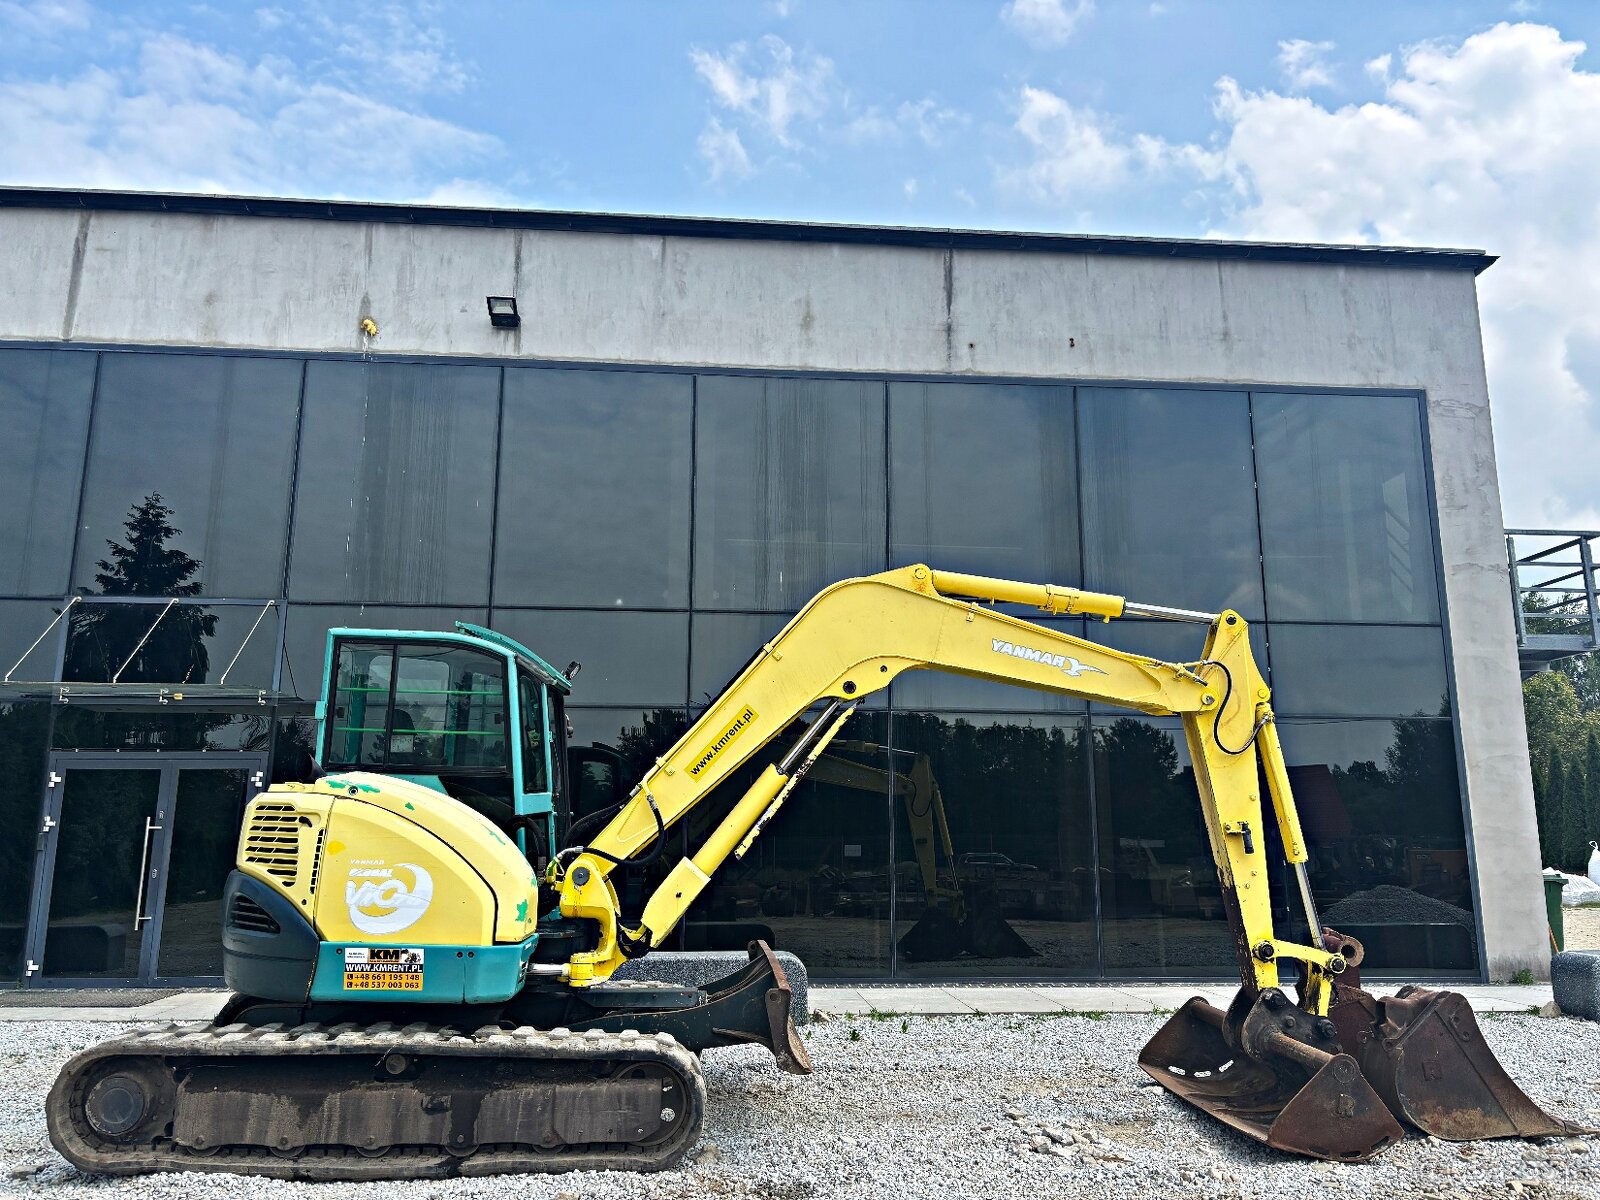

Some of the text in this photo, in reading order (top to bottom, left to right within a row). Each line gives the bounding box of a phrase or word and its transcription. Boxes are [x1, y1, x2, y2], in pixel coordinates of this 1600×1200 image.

[991, 638, 1066, 668] YANMAR
[690, 708, 754, 775] www.kmrent.pl
[369, 949, 401, 960] KM
[345, 963, 423, 973] WWW.KMRENT.PL
[354, 973, 370, 981] +48
[371, 973, 386, 981] 661
[388, 973, 403, 981] 195
[354, 981, 369, 989] +48
[371, 981, 386, 989] 537
[387, 981, 403, 989] 003
